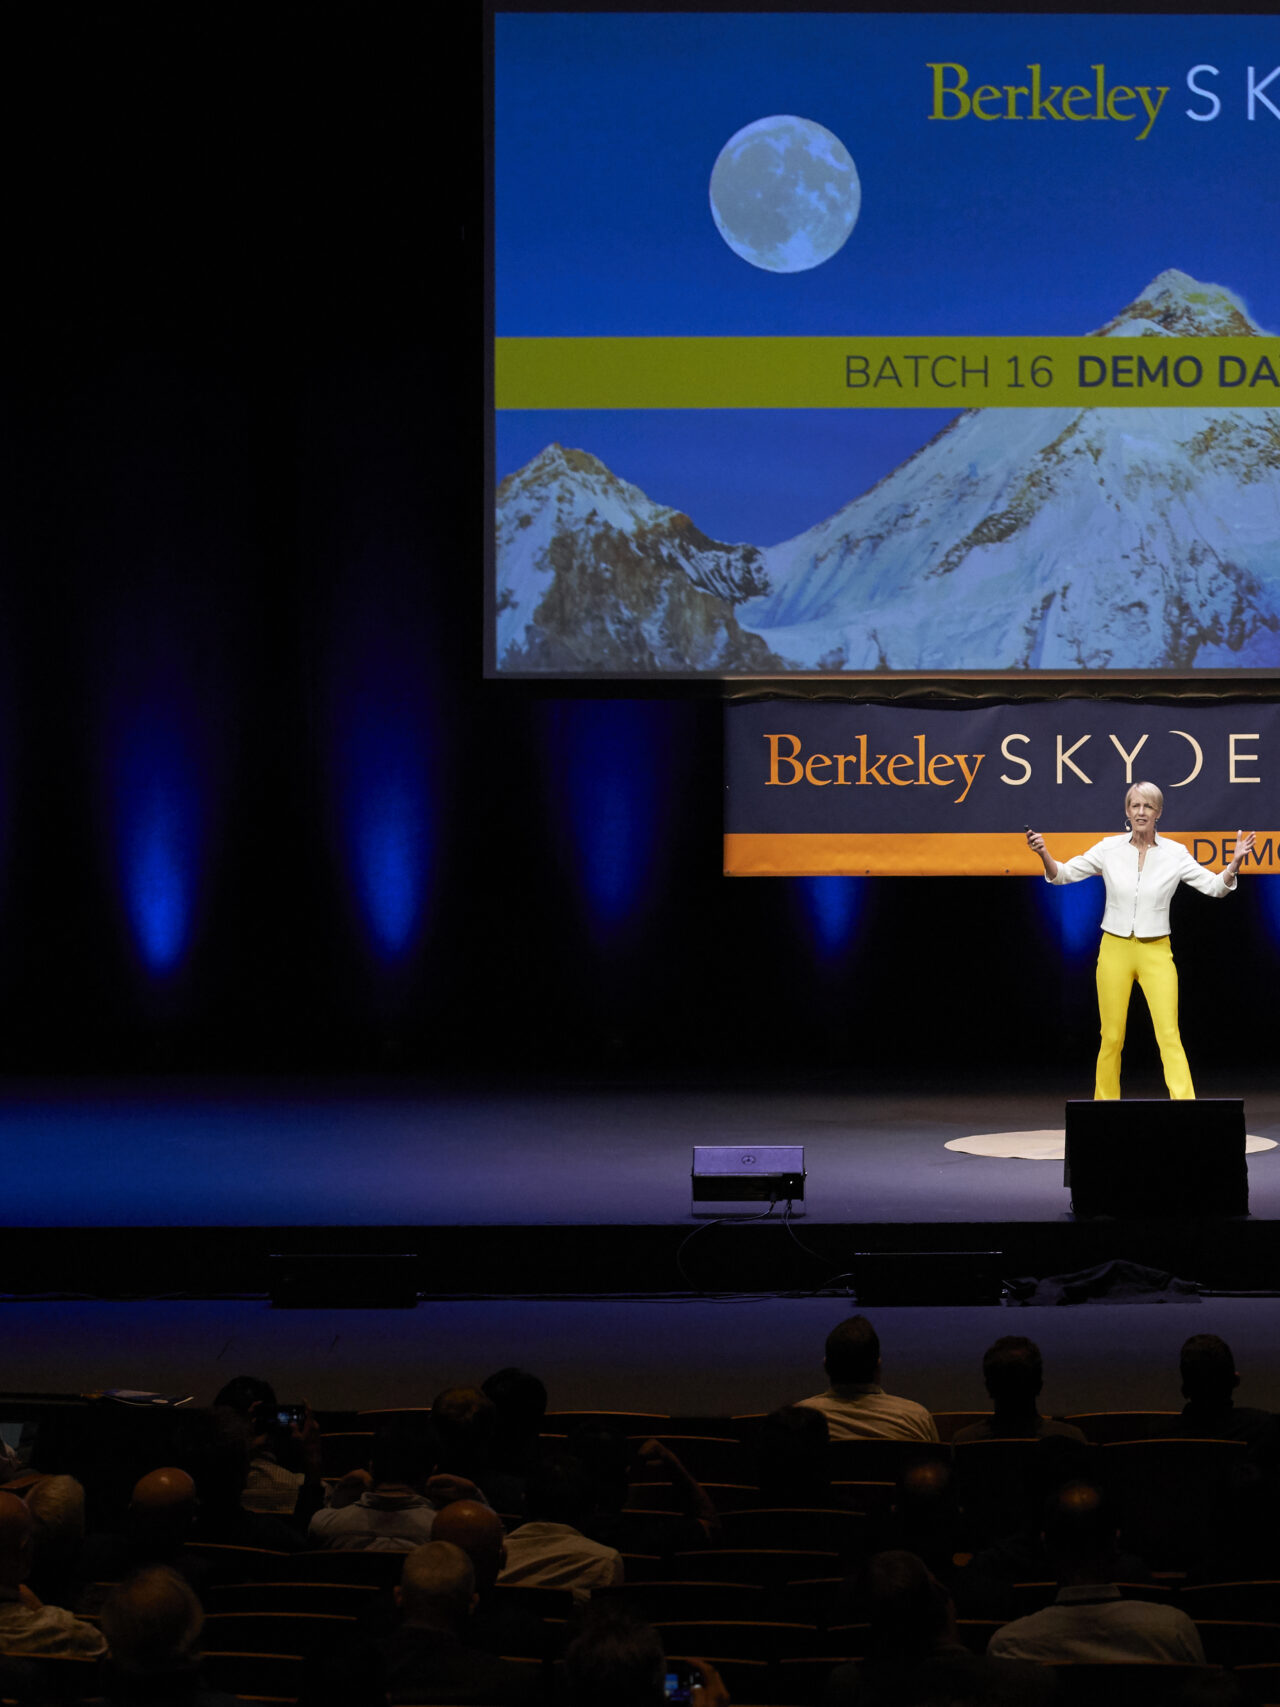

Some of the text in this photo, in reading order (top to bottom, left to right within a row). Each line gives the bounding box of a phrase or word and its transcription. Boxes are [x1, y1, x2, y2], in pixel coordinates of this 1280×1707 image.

[926, 63, 1170, 140] Berkeley
[845, 355, 989, 388] BATCH
[1006, 355, 1054, 388] 16
[1078, 355, 1204, 388] DEMO
[764, 734, 985, 803] Berkeley
